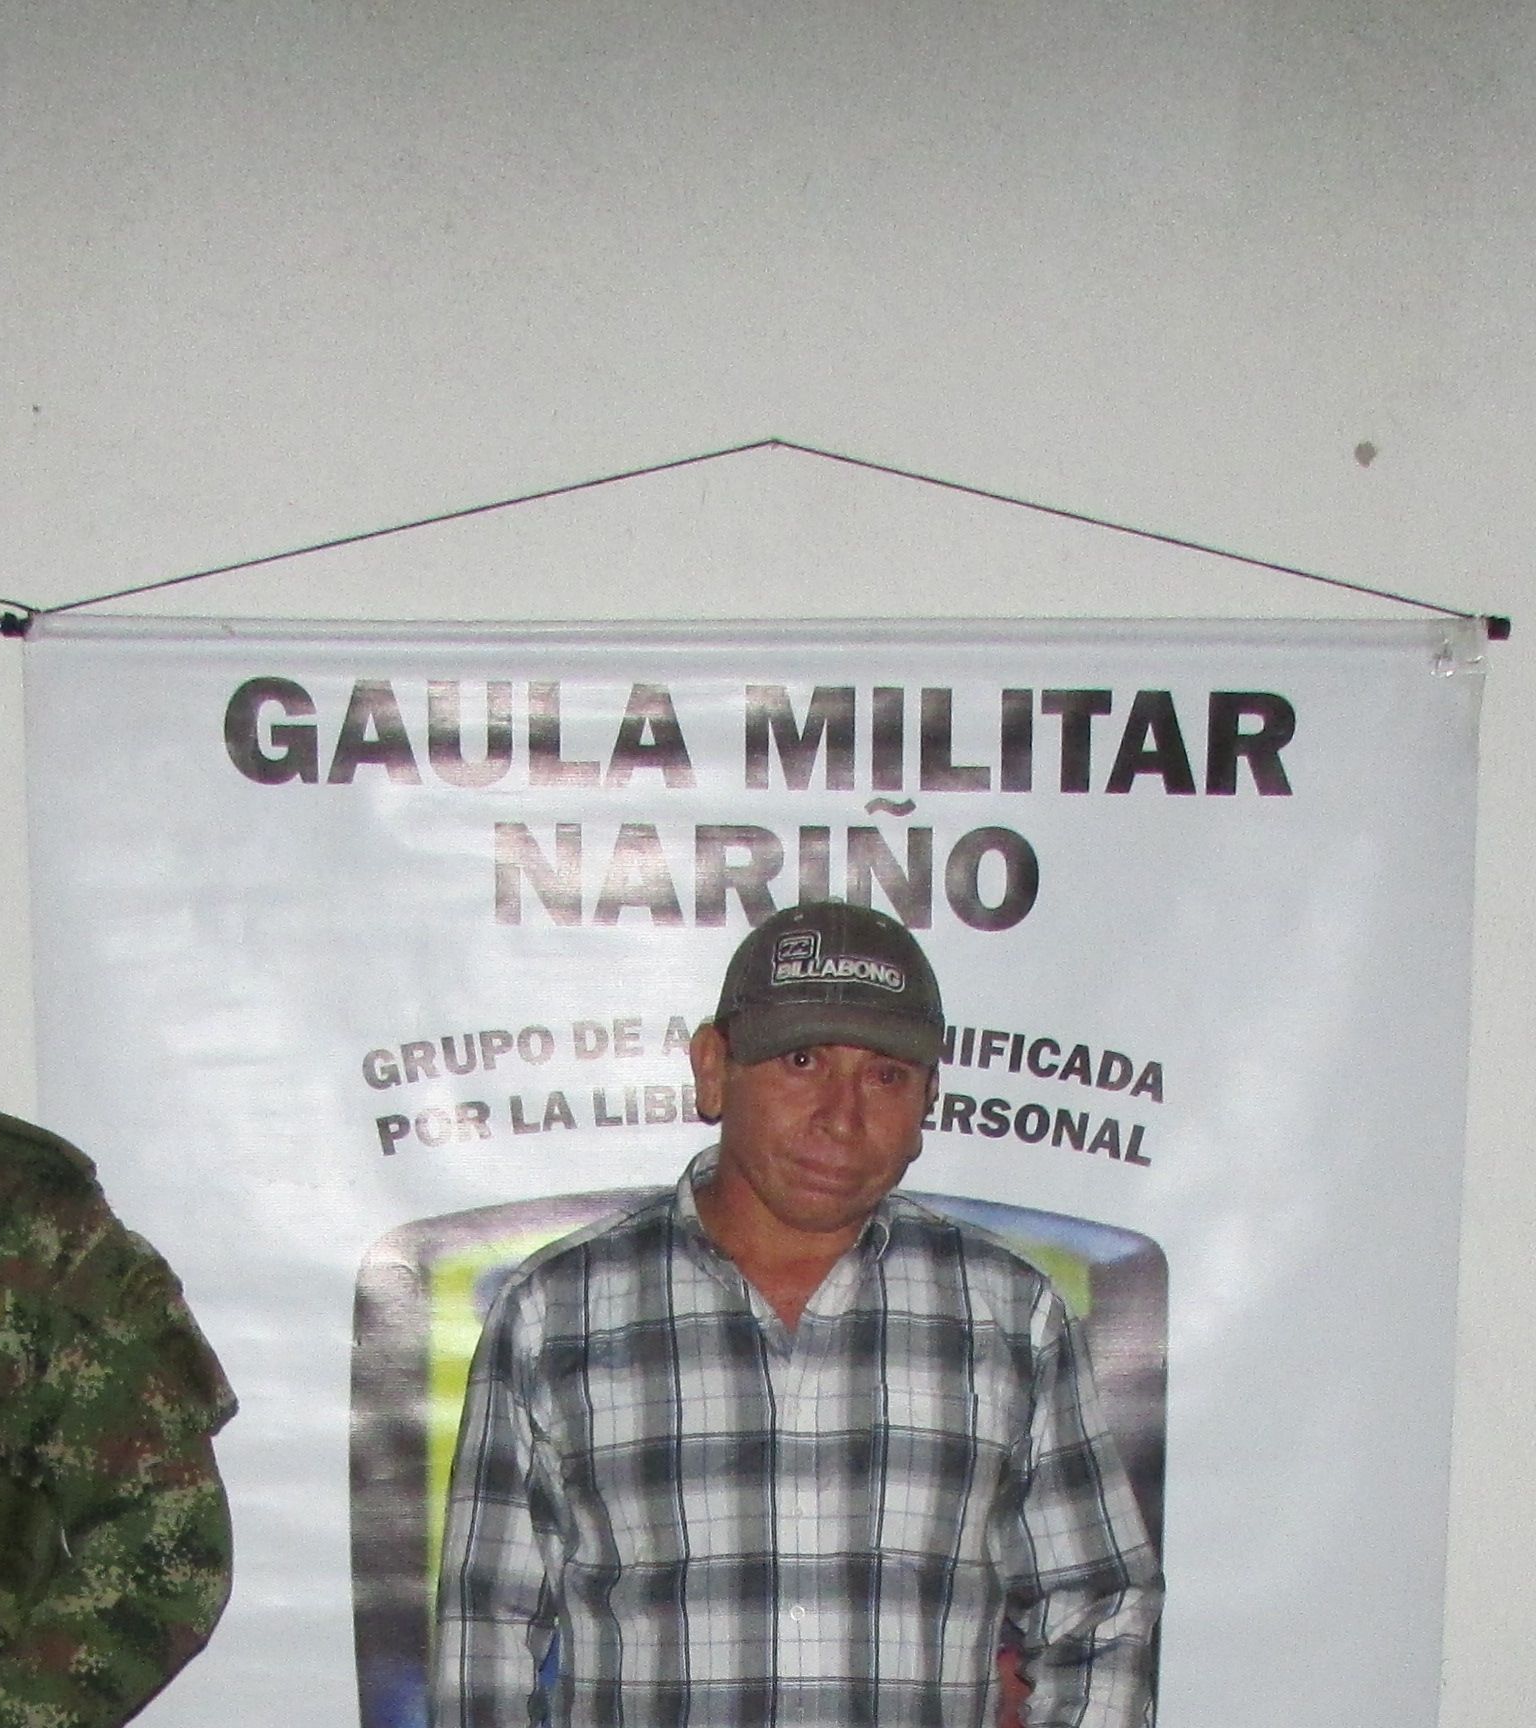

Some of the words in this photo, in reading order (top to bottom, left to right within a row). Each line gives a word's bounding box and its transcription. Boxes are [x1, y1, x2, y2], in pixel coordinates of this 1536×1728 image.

[224, 676, 697, 790] GAULA
[744, 684, 1297, 797] MILITAR
[494, 797, 1040, 932] NARIÑO
[776, 958, 903, 988] BILLABONG
[362, 1024, 556, 1091] GRUPO
[571, 1017, 644, 1061] DE
[938, 1024, 1164, 1104] NIFICADA
[375, 1100, 492, 1156] POR
[509, 1090, 577, 1135] LA
